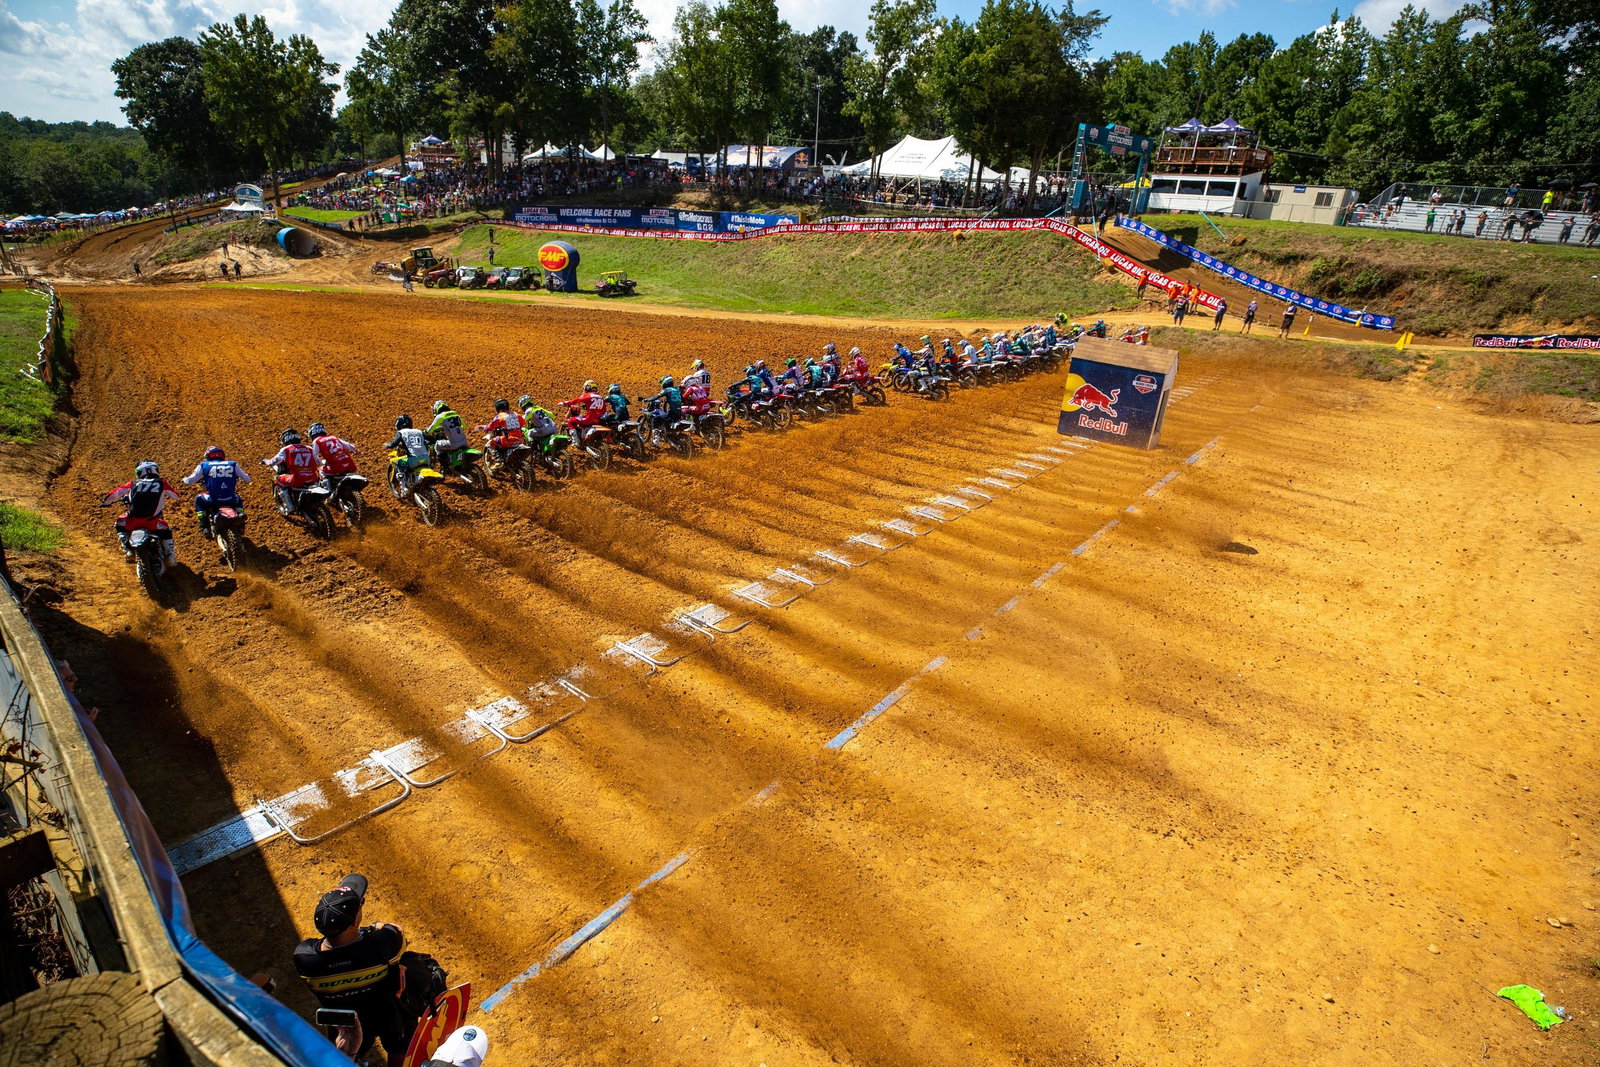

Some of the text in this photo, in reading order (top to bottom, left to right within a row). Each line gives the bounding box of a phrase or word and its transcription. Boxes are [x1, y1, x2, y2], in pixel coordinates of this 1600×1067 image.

[560, 208, 632, 218] WELCOME RACE FANS
[1066, 228, 1077, 236] OIL
[1078, 234, 1110, 256] LUCAS OIL
[539, 252, 564, 262] FMF
[1110, 253, 1133, 270] LUCAS
[1207, 294, 1221, 306] OIL
[702, 374, 710, 384] 18
[326, 440, 344, 454] 24
[294, 453, 311, 466] 47
[208, 466, 234, 478] 432
[136, 482, 160, 492] 172
[317, 968, 388, 988] DUNLOP
